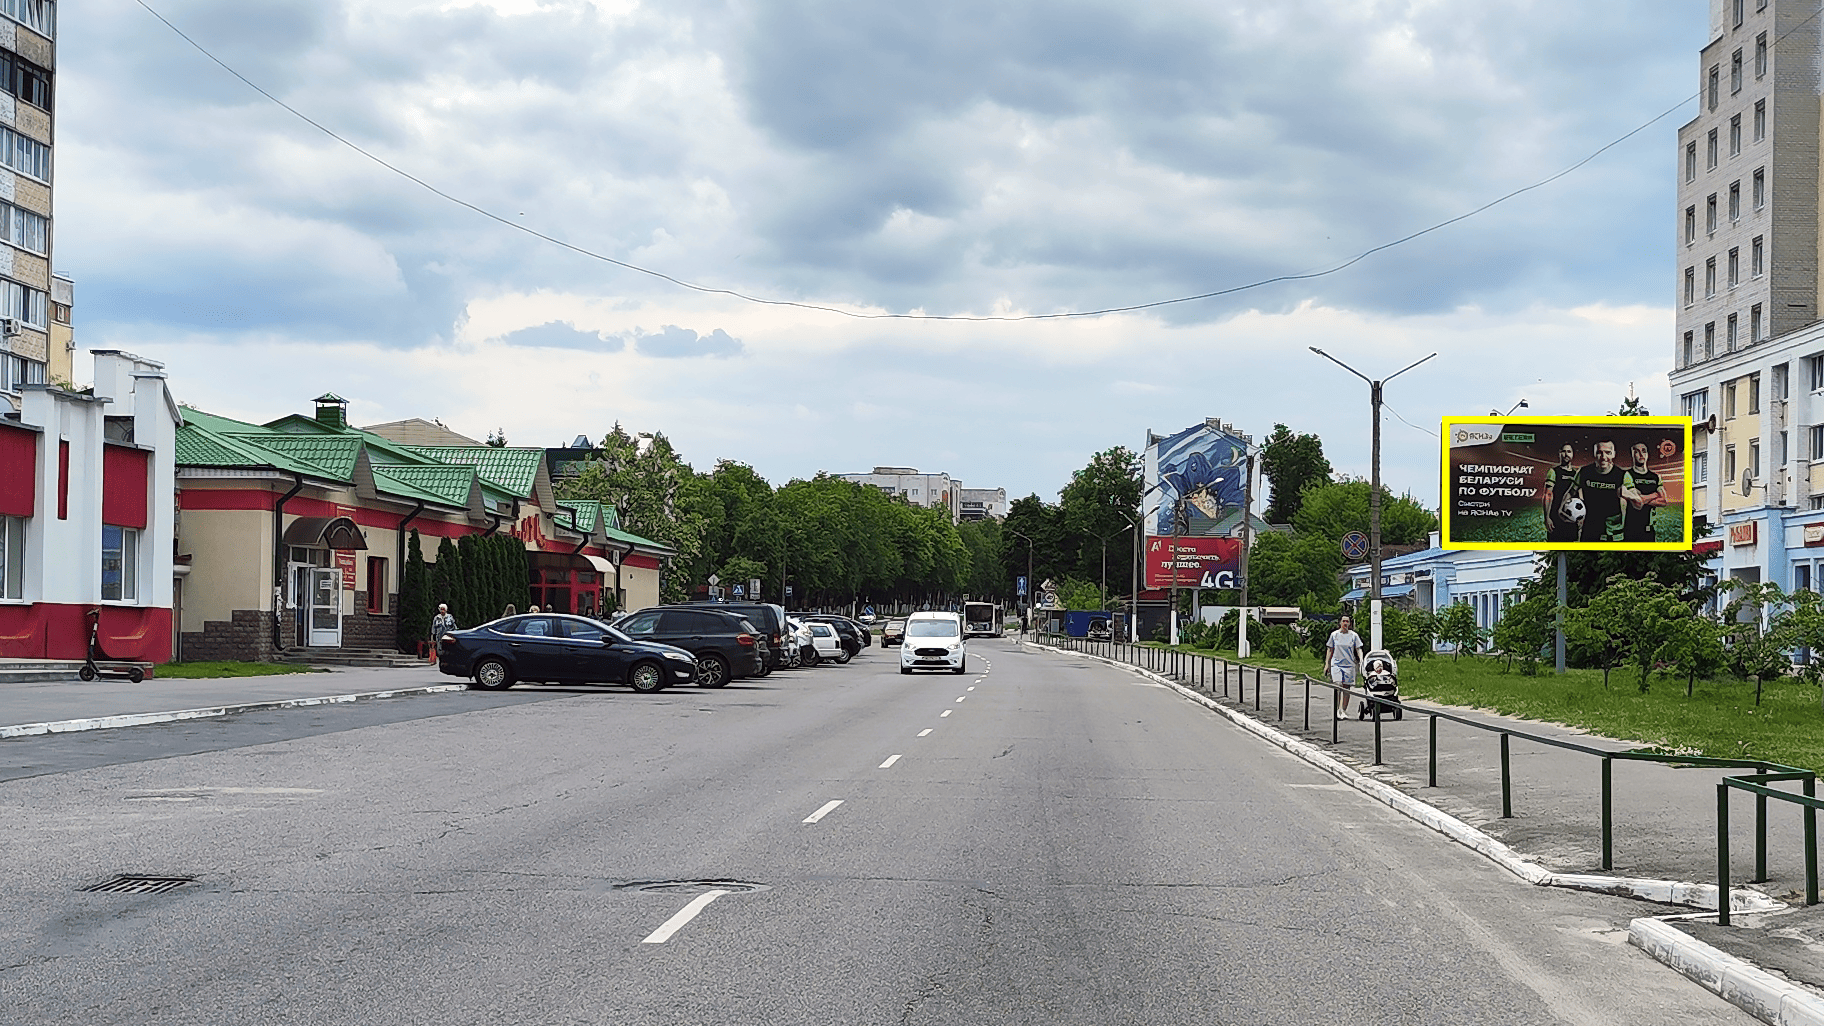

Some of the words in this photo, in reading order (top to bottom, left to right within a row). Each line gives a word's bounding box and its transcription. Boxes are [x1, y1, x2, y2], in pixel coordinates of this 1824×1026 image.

[1459, 464, 1535, 474] ЧЕМПИОНАТ
[1459, 475, 1524, 485] БЕЛАРУСИ
[1458, 486, 1476, 496] ПО
[1479, 487, 1538, 497] ФУТБОЛУ
[1200, 570, 1234, 589] 4G
